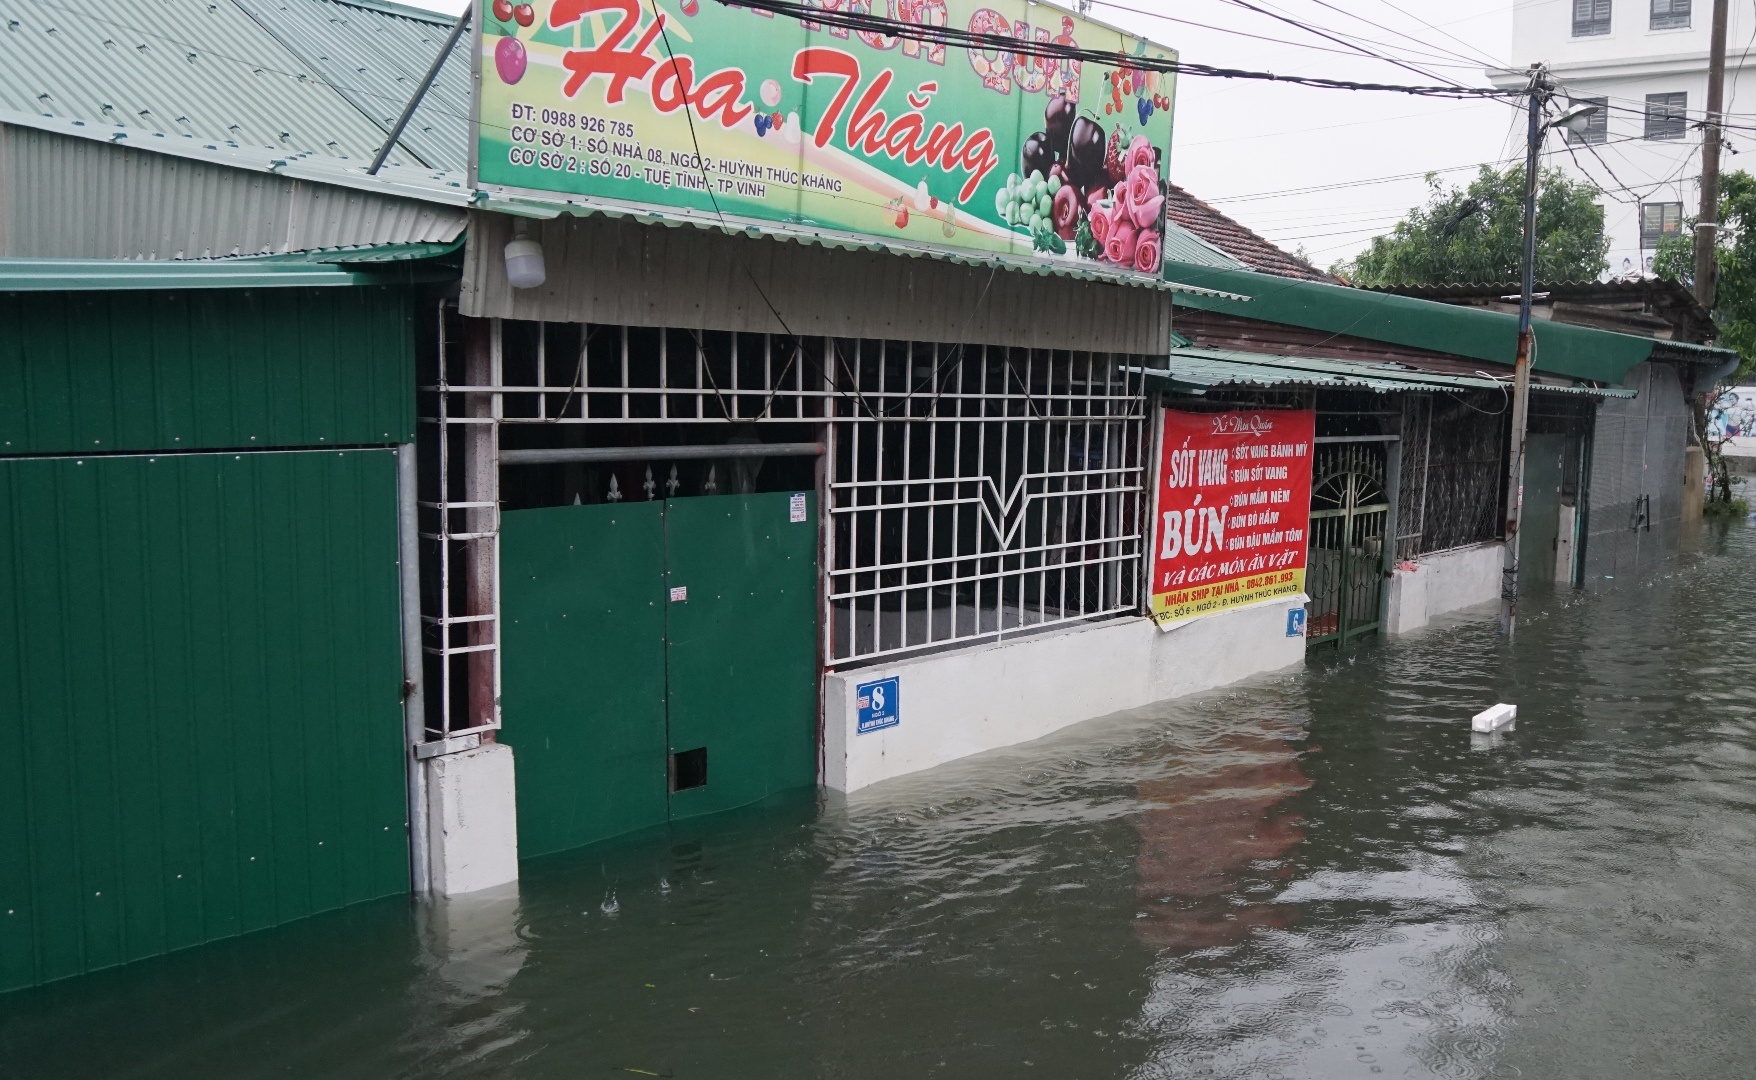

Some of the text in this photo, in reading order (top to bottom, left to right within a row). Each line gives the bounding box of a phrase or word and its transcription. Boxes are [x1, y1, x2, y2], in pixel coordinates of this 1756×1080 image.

[967, 8, 1081, 104] QUẢ
[549, 0, 998, 203] Hoa Thắng
[511, 103, 634, 138] ĐT: 0988 926 785
[510, 148, 536, 164] CƠ
[540, 150, 564, 169] SỞ
[568, 156, 576, 172] 2
[590, 157, 611, 175] SỐ
[615, 163, 631, 178] 20
[644, 167, 671, 188] TUỆ
[675, 171, 705, 190] TĨNH
[718, 178, 733, 192] TP
[736, 181, 766, 197] VINH
[511, 126, 537, 143] CƠ
[541, 129, 565, 147] SỞ
[570, 135, 582, 150] 1:
[587, 134, 608, 154] SỐ
[613, 142, 643, 160] NHÀ
[647, 148, 666, 166] 08,
[670, 152, 700, 169] NGÕ
[719, 159, 762, 178] HUỲNH
[767, 167, 798, 184] THÚC
[802, 173, 842, 192] KHÁNG
[1169, 436, 1229, 489] SỐT VANG
[1235, 442, 1249, 460] SỐT
[1250, 444, 1269, 459] VANG
[1270, 441, 1294, 458] BÁNH
[1234, 463, 1288, 483] BÚN SỐT VANG
[1233, 491, 1249, 508] BÚN
[1270, 487, 1291, 504] NÊM
[1161, 493, 1229, 560] BÚN
[1231, 513, 1247, 529] BÚN
[1229, 534, 1245, 551] BÚN
[1285, 527, 1303, 542] TÔM
[1163, 548, 1299, 587] VÀ CÁC MÓN ĂN VẶT
[1165, 590, 1189, 608] NHẬN
[1191, 587, 1209, 602] SHIP
[1211, 585, 1224, 599] TẠI
[1224, 579, 1240, 595] NHÀ
[1174, 604, 1185, 617] SỐ
[1185, 606, 1191, 615] 6
[1212, 600, 1217, 609] 2
[1230, 591, 1254, 605] HUỲNH
[1293, 613, 1298, 630] 6
[872, 687, 884, 710] 8
